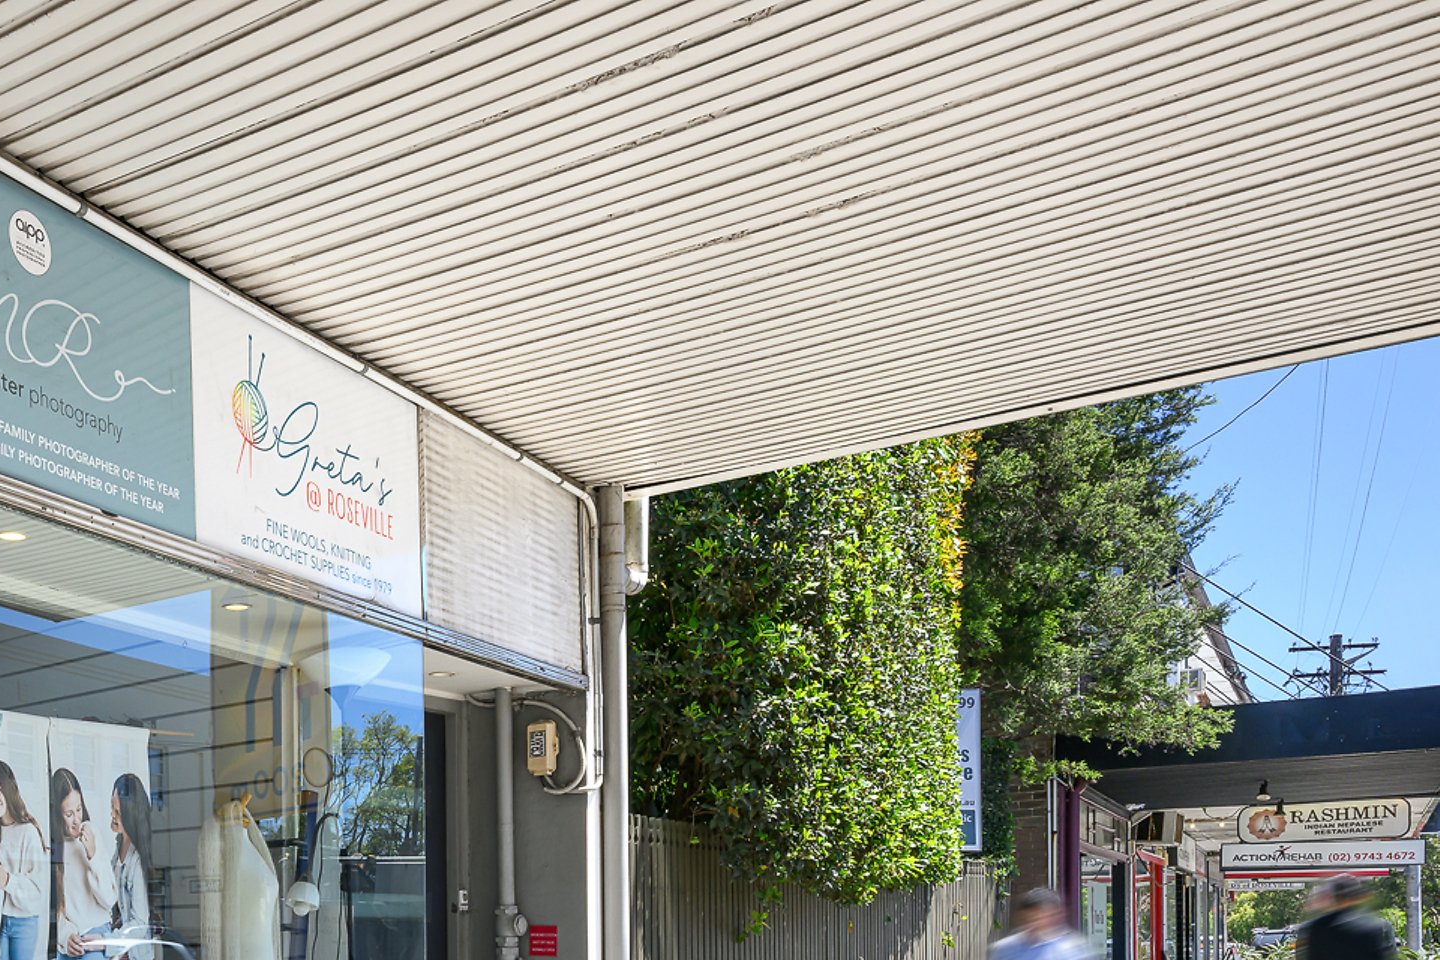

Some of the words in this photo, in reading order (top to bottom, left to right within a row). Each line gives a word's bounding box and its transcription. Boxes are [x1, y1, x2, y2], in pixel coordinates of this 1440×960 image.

[16, 218, 45, 244] aipp
[29, 386, 123, 443] photography
[38, 436, 120, 477] PHOTOGRAPHER
[122, 468, 135, 482] OF
[137, 473, 155, 491] THE
[157, 481, 180, 499] YEAR
[272, 401, 393, 506] Greta's
[18, 449, 103, 492] PHOTOGRAPHER
[104, 482, 118, 496] OF
[120, 487, 138, 505] THE
[140, 495, 164, 513] YEAR
[306, 481, 322, 512] @
[327, 488, 394, 541] ROSEVILLE
[240, 533, 259, 549] and
[261, 537, 308, 566] CROCHET
[311, 555, 350, 581] SUPPLIES
[351, 571, 372, 589] since
[373, 577, 392, 594] 1979
[266, 518, 289, 540] FINE
[290, 527, 329, 556] WOOLS,
[330, 543, 372, 570] KNITTING
[1289, 804, 1398, 824] RASHMIN
[1314, 827, 1373, 835] RESTAURANT
[1337, 820, 1384, 828] NEPALESE
[1284, 853, 1323, 861] REHAB
[1328, 852, 1351, 862] (02)
[1354, 852, 1382, 860] 9743
[1386, 851, 1416, 860] 4672
